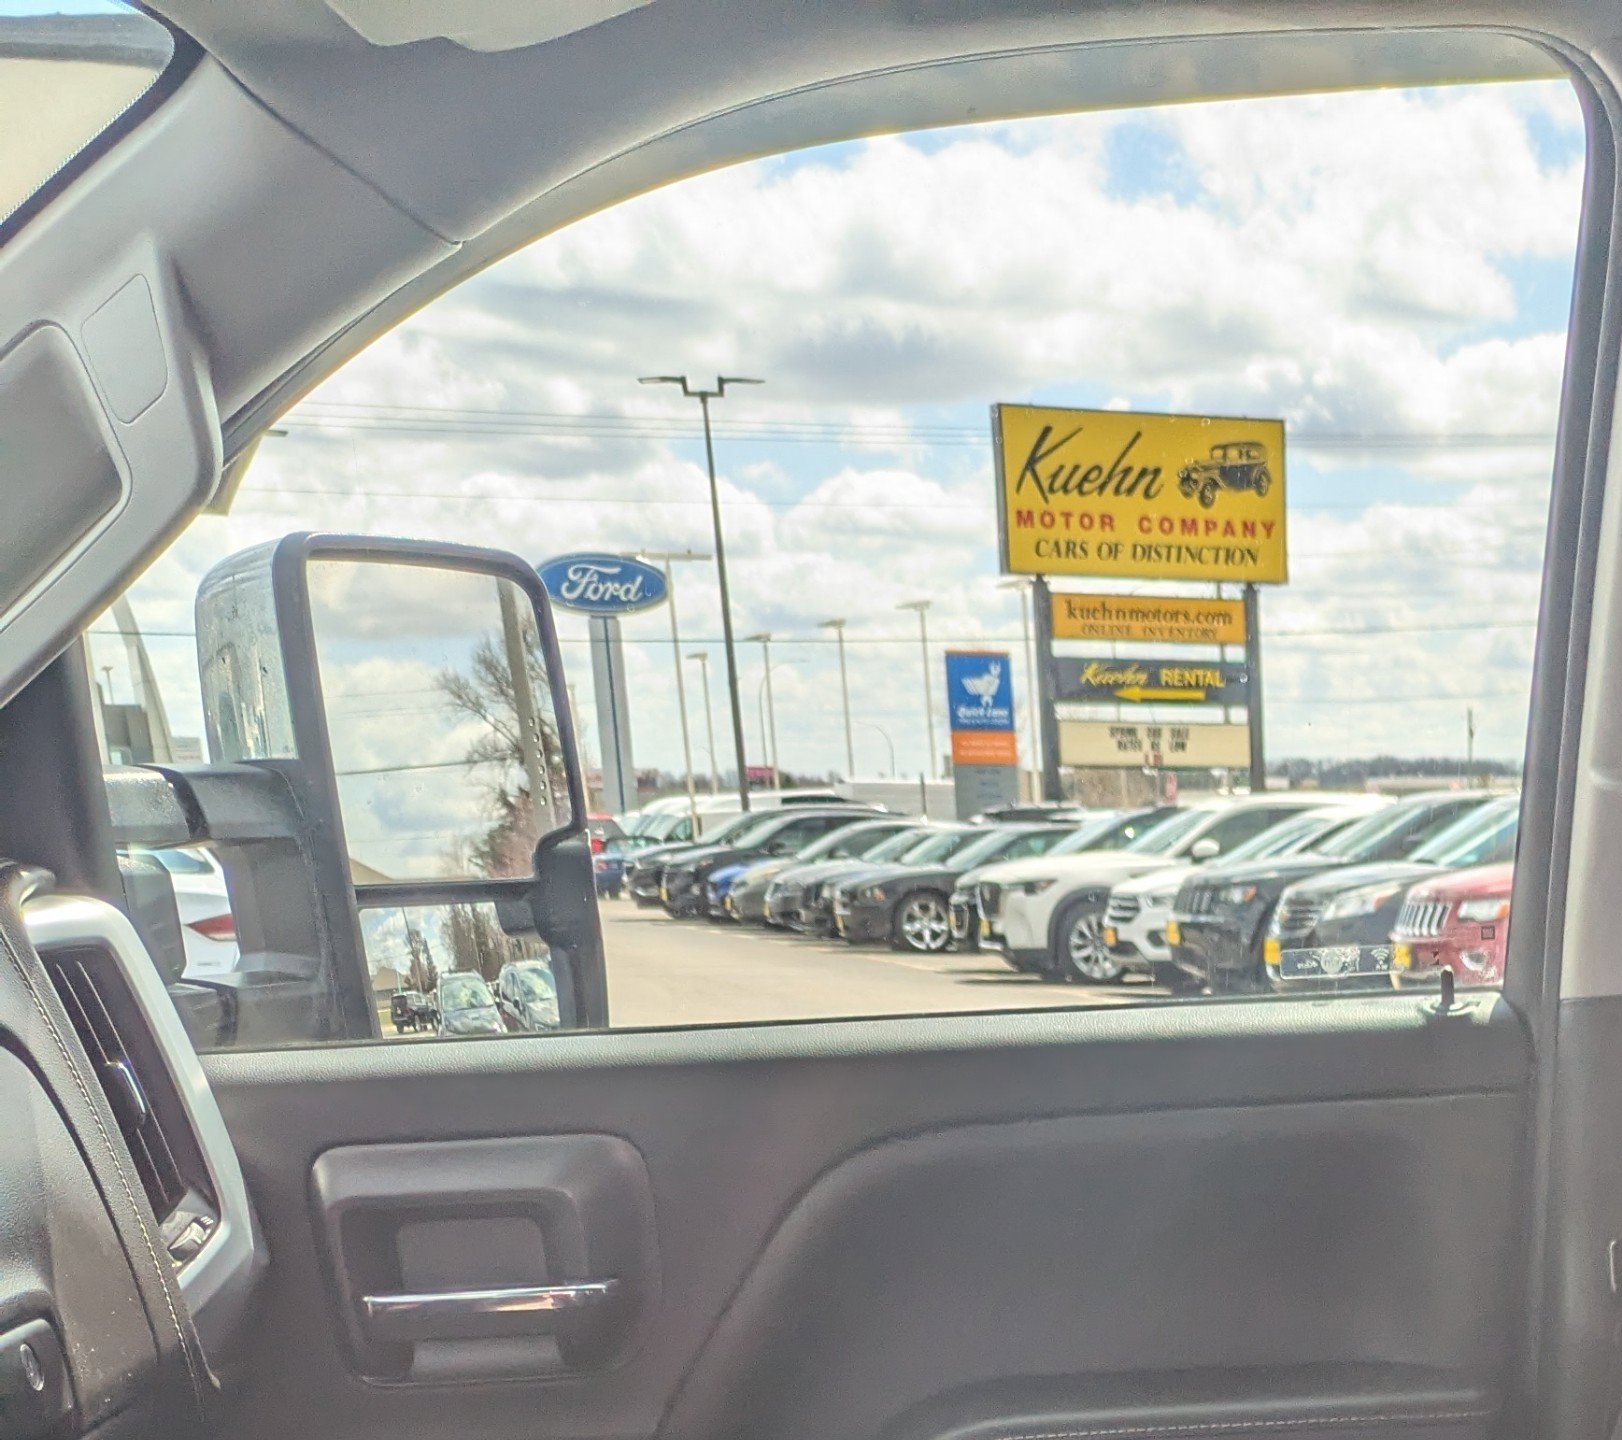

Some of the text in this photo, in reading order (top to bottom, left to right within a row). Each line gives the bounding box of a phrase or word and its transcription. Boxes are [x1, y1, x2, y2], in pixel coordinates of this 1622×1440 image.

[1016, 426, 1164, 504] Kuehn
[1016, 509, 1276, 540] MOTOR COMPANY
[1035, 538, 1260, 567] CARS OF DISTINCTION
[560, 563, 644, 602] Ford
[1065, 599, 1233, 626] kuehnmotors.com
[1159, 667, 1226, 688] RENTAL
